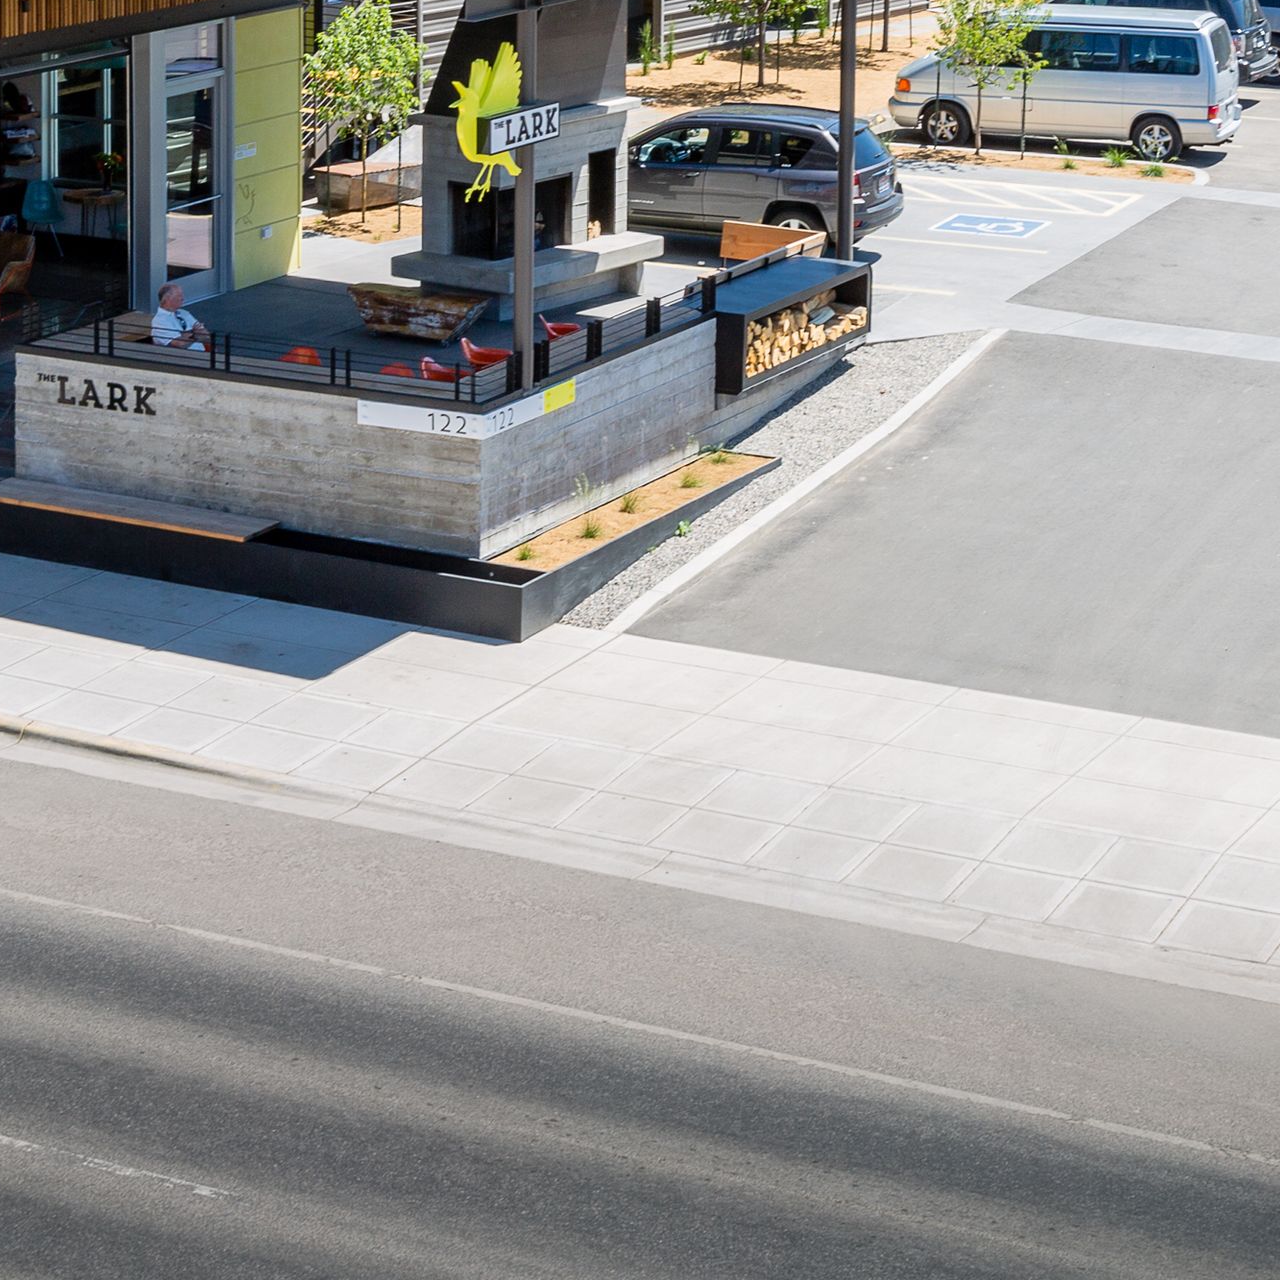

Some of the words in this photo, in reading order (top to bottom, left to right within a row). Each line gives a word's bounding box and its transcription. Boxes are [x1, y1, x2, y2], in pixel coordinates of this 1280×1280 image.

[494, 120, 505, 130] THE
[505, 107, 558, 146] LARK
[37, 373, 57, 383] THE
[57, 375, 157, 416] LARK
[427, 412, 467, 435] 122
[492, 407, 514, 432] 122
